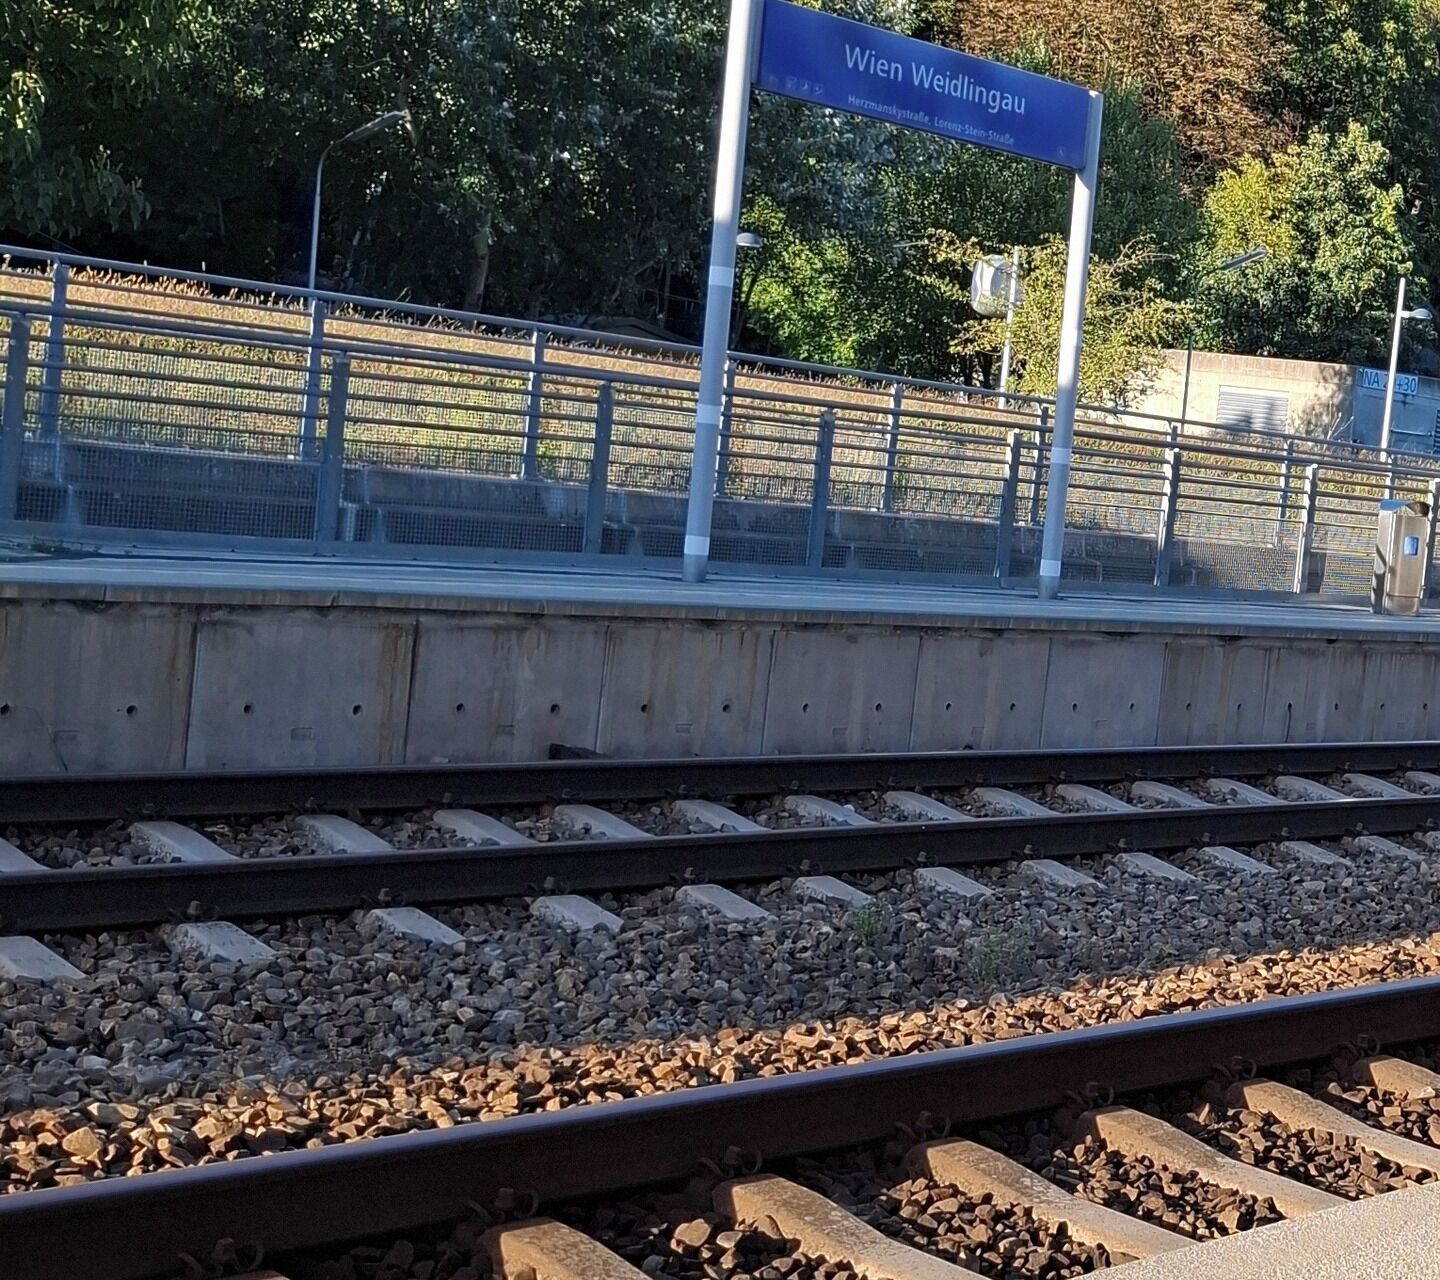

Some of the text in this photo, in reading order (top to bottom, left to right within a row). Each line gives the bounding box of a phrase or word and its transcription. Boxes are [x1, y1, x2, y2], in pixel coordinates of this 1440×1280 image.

[845, 43, 1026, 115] Wien Weidlingau
[934, 116, 1014, 144] Lorenz-Stein-Straße
[1364, 370, 1380, 387] NA
